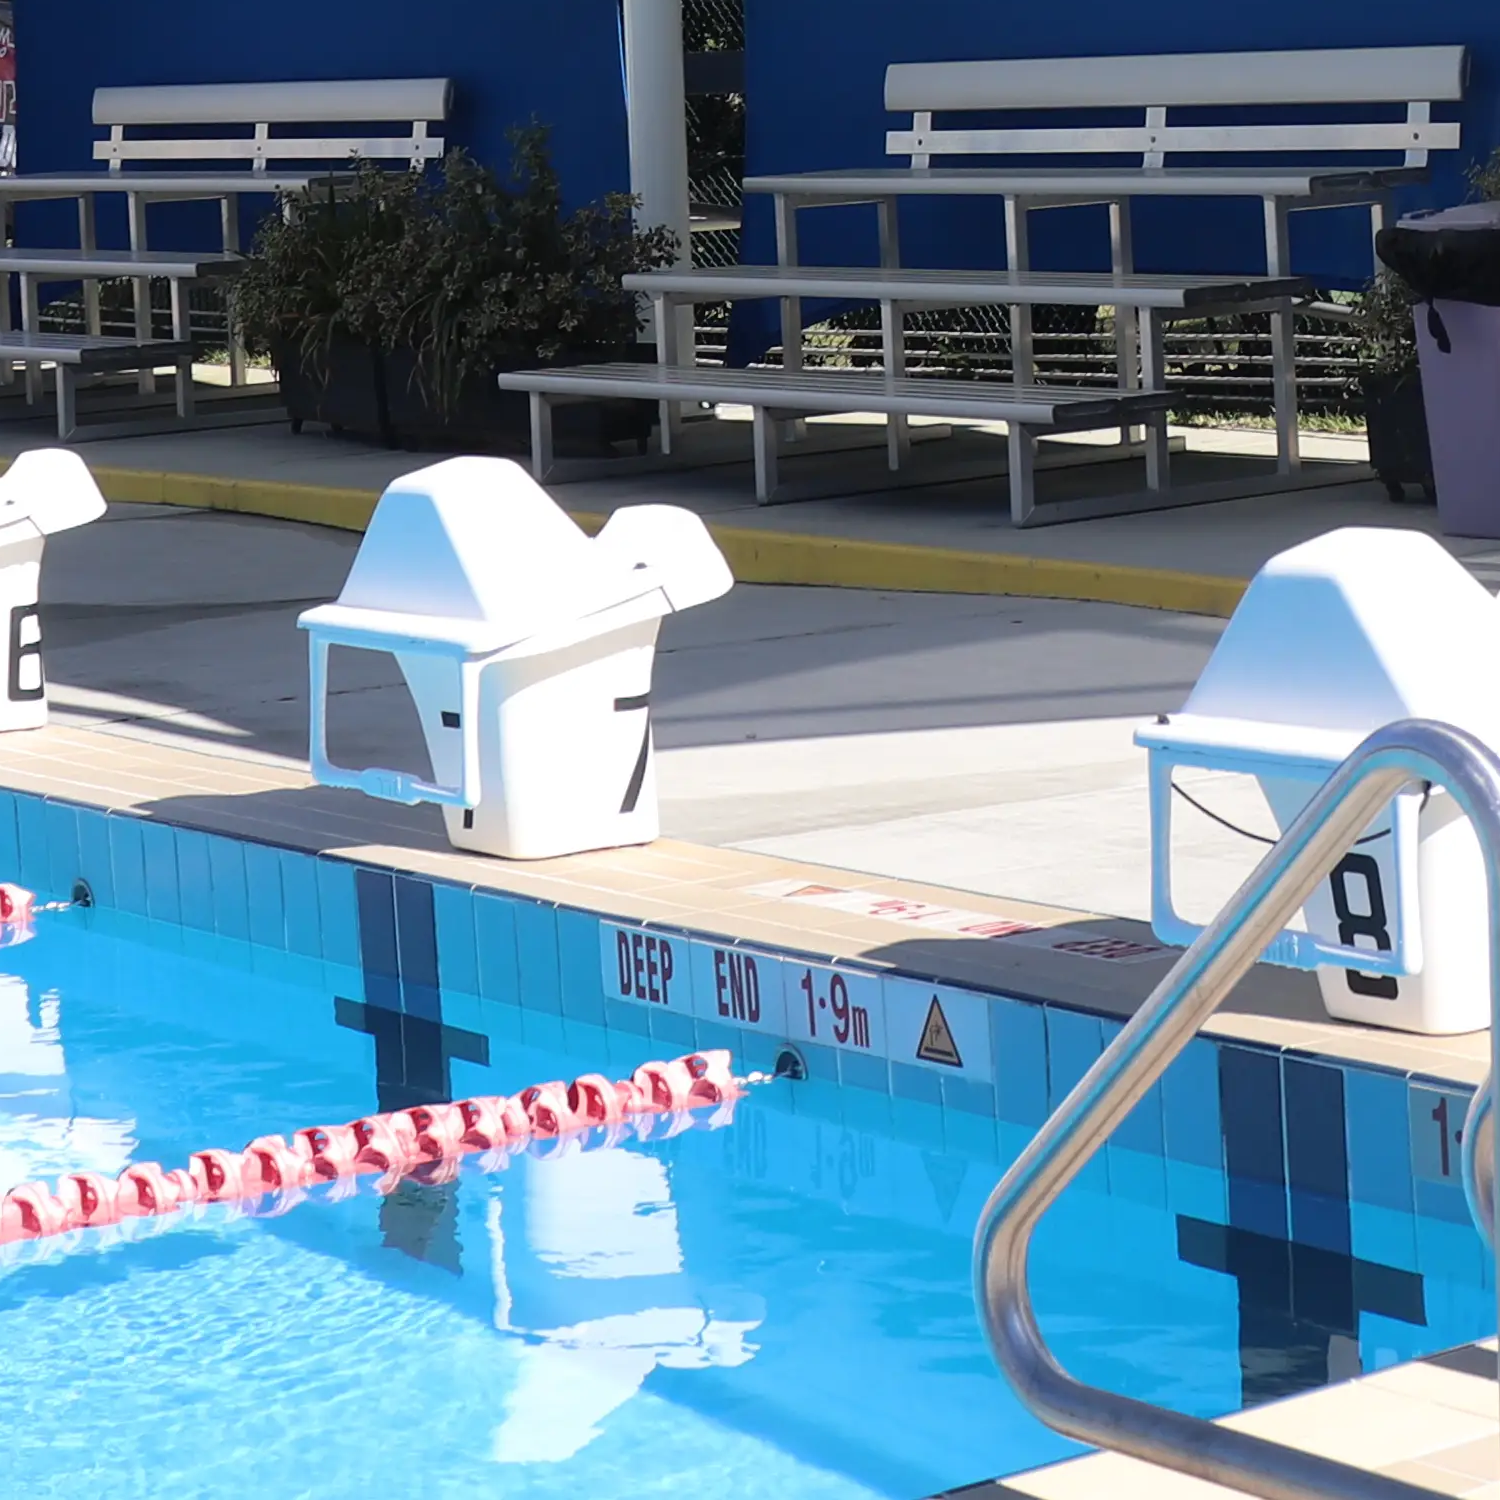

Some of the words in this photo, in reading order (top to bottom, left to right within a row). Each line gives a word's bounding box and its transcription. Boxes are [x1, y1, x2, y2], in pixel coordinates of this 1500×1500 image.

[613, 691, 651, 814] 7
[616, 930, 673, 1005] DEEP
[713, 950, 761, 1023] END
[1329, 852, 1398, 1000] 8
